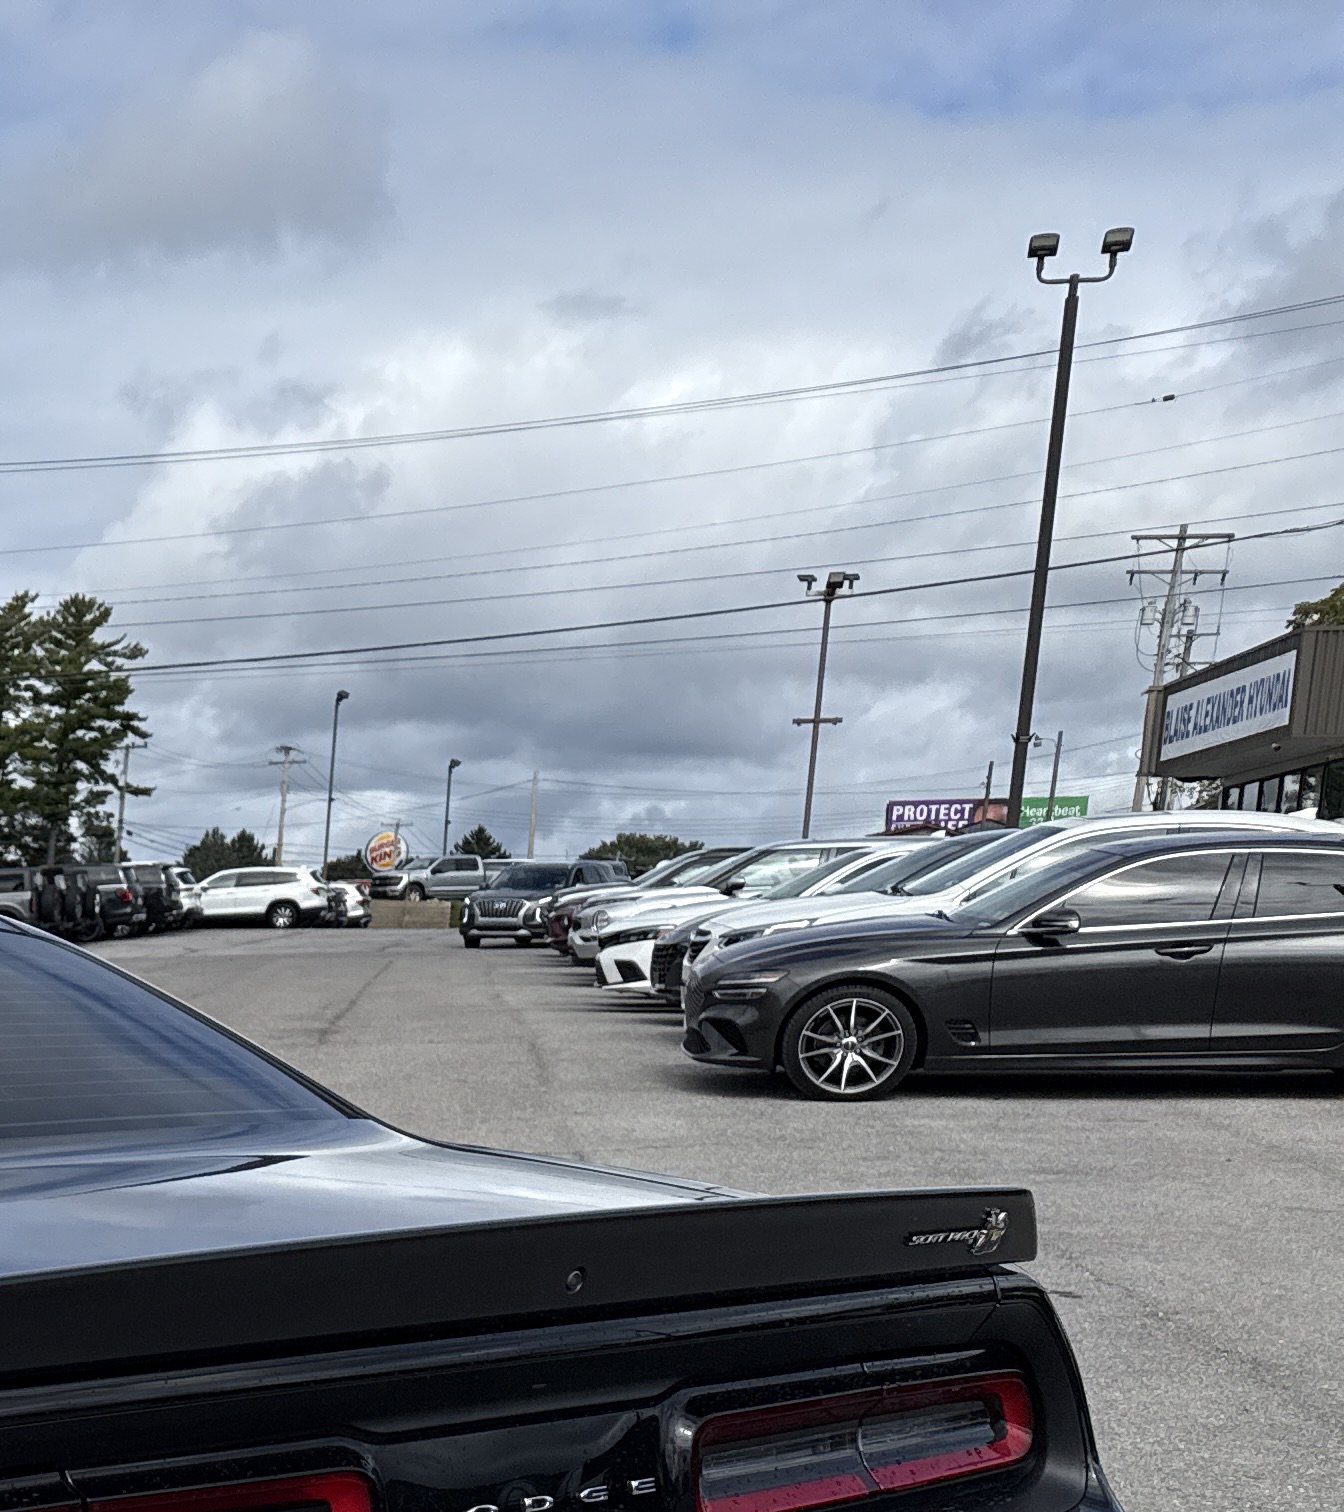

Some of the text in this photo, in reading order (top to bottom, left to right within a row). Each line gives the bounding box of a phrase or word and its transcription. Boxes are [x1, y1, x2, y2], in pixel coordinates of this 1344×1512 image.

[1163, 668, 1291, 745] BLAISE ALEXANDER HYUNDAI
[892, 804, 974, 821] PROTECT
[1020, 805, 1081, 817] Hearbeat
